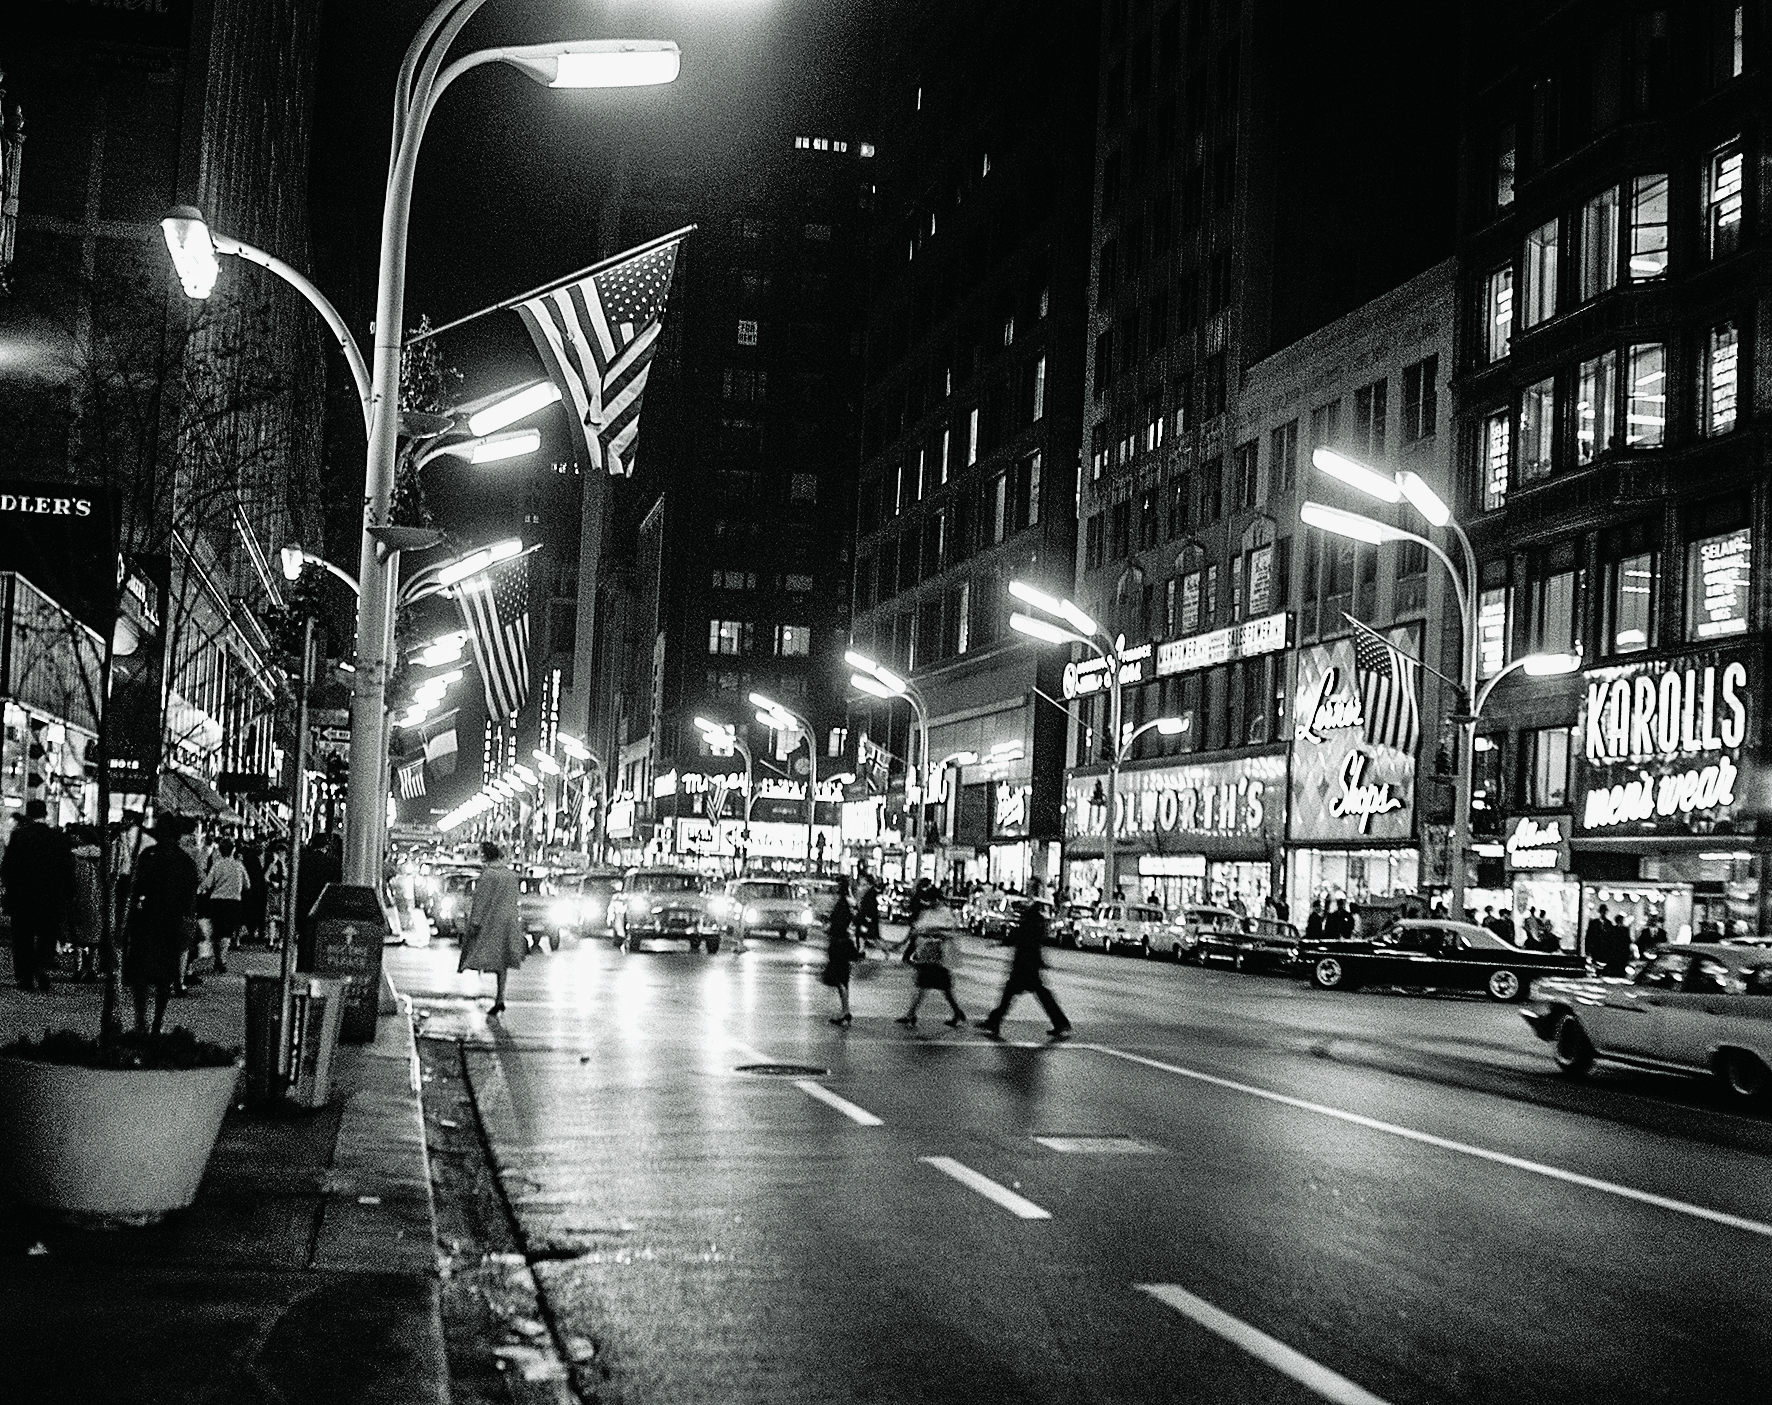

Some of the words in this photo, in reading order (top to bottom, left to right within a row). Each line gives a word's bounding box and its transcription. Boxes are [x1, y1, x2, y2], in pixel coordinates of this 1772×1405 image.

[1586, 662, 1747, 759] KAROLLS
[1329, 750, 1402, 834] Shops
[1583, 770, 1656, 830] men's
[1656, 756, 1738, 816] wear
